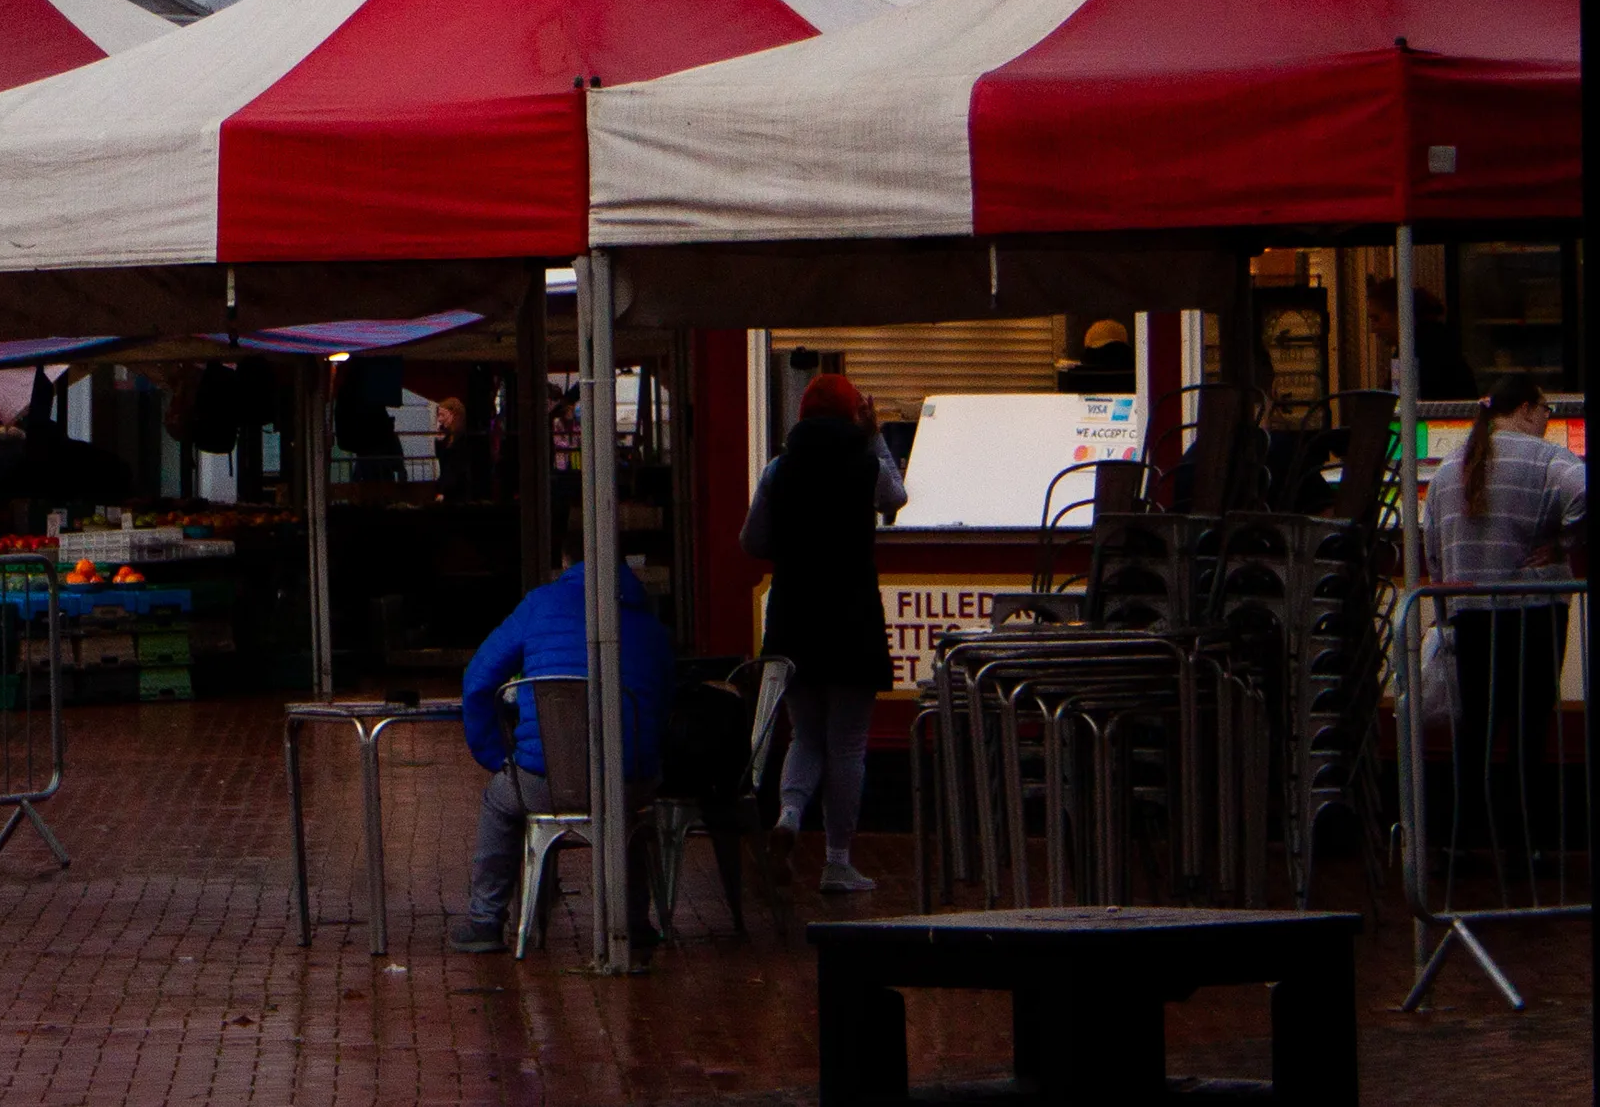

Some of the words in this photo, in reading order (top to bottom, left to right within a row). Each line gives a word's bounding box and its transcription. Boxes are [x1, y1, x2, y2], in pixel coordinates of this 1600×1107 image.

[1087, 404, 1108, 414] VISA
[1076, 427, 1090, 438] WE
[1091, 427, 1128, 439] ACCEPT
